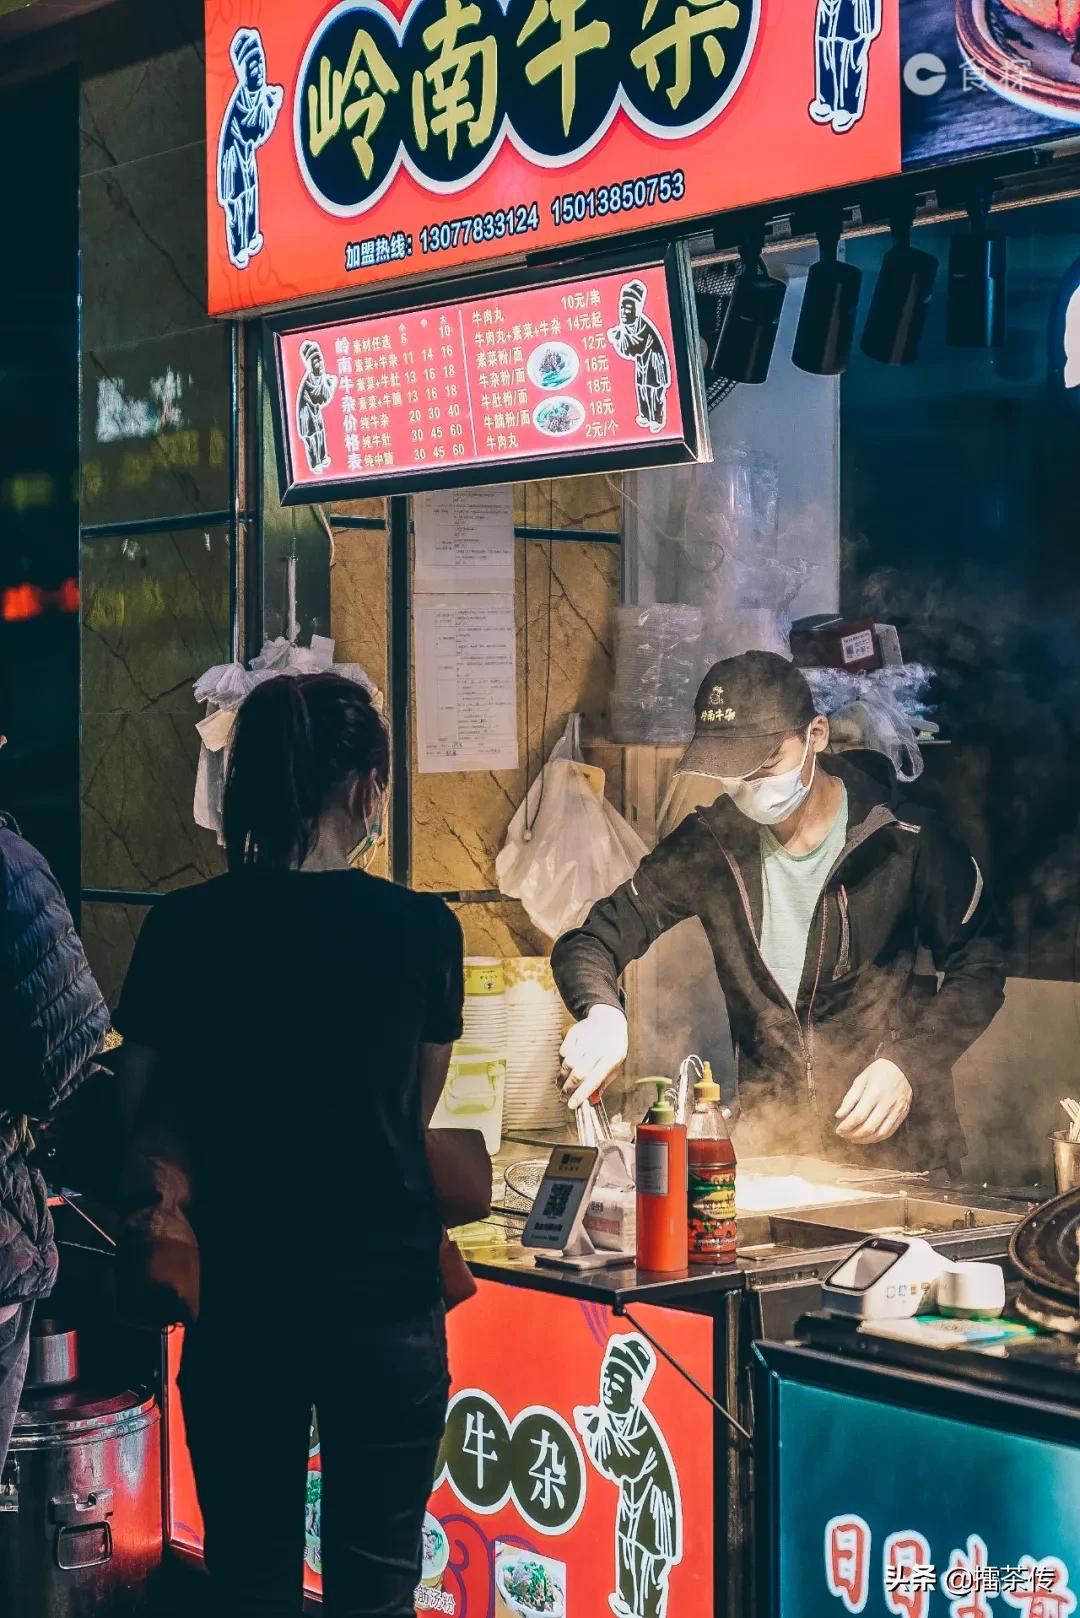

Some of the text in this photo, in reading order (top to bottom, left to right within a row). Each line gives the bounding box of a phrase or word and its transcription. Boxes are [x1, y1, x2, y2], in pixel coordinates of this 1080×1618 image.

[308, 0, 740, 180] 岭南牛杂
[420, 203, 538, 253] 13077833124
[551, 171, 685, 226] 15013850753
[472, 288, 600, 327] 牛肉丸 10元/串
[400, 333, 408, 344] 6
[439, 325, 451, 338] 10
[474, 311, 602, 346] 牛肉丸+素菜+牛杂 14元起
[403, 352, 414, 364] 11
[422, 348, 433, 361] 14
[441, 344, 453, 358] 16
[477, 333, 606, 368] 素菜粉/面 12元
[405, 371, 416, 384] 13
[424, 368, 436, 380] 16
[443, 364, 455, 378] 18
[480, 355, 609, 388] 牛杂粉/面 16元
[335, 337, 363, 470] 岭南牛杂价格表
[407, 390, 418, 402] 13
[426, 388, 438, 400] 16
[445, 384, 457, 396] 18
[482, 376, 612, 409] 牛肚粉/面 18元
[590, 398, 614, 416] 18元
[410, 410, 421, 423] 20
[428, 407, 440, 420] 30
[448, 404, 460, 417] 40
[412, 429, 424, 442] 30
[431, 426, 442, 439] 45
[450, 424, 462, 436] 60
[486, 419, 618, 451] 牛肉丸 2元/个
[414, 448, 426, 461] 30
[433, 446, 445, 458] 45
[452, 444, 464, 456] 60
[463, 1411, 567, 1509] 牛杂
